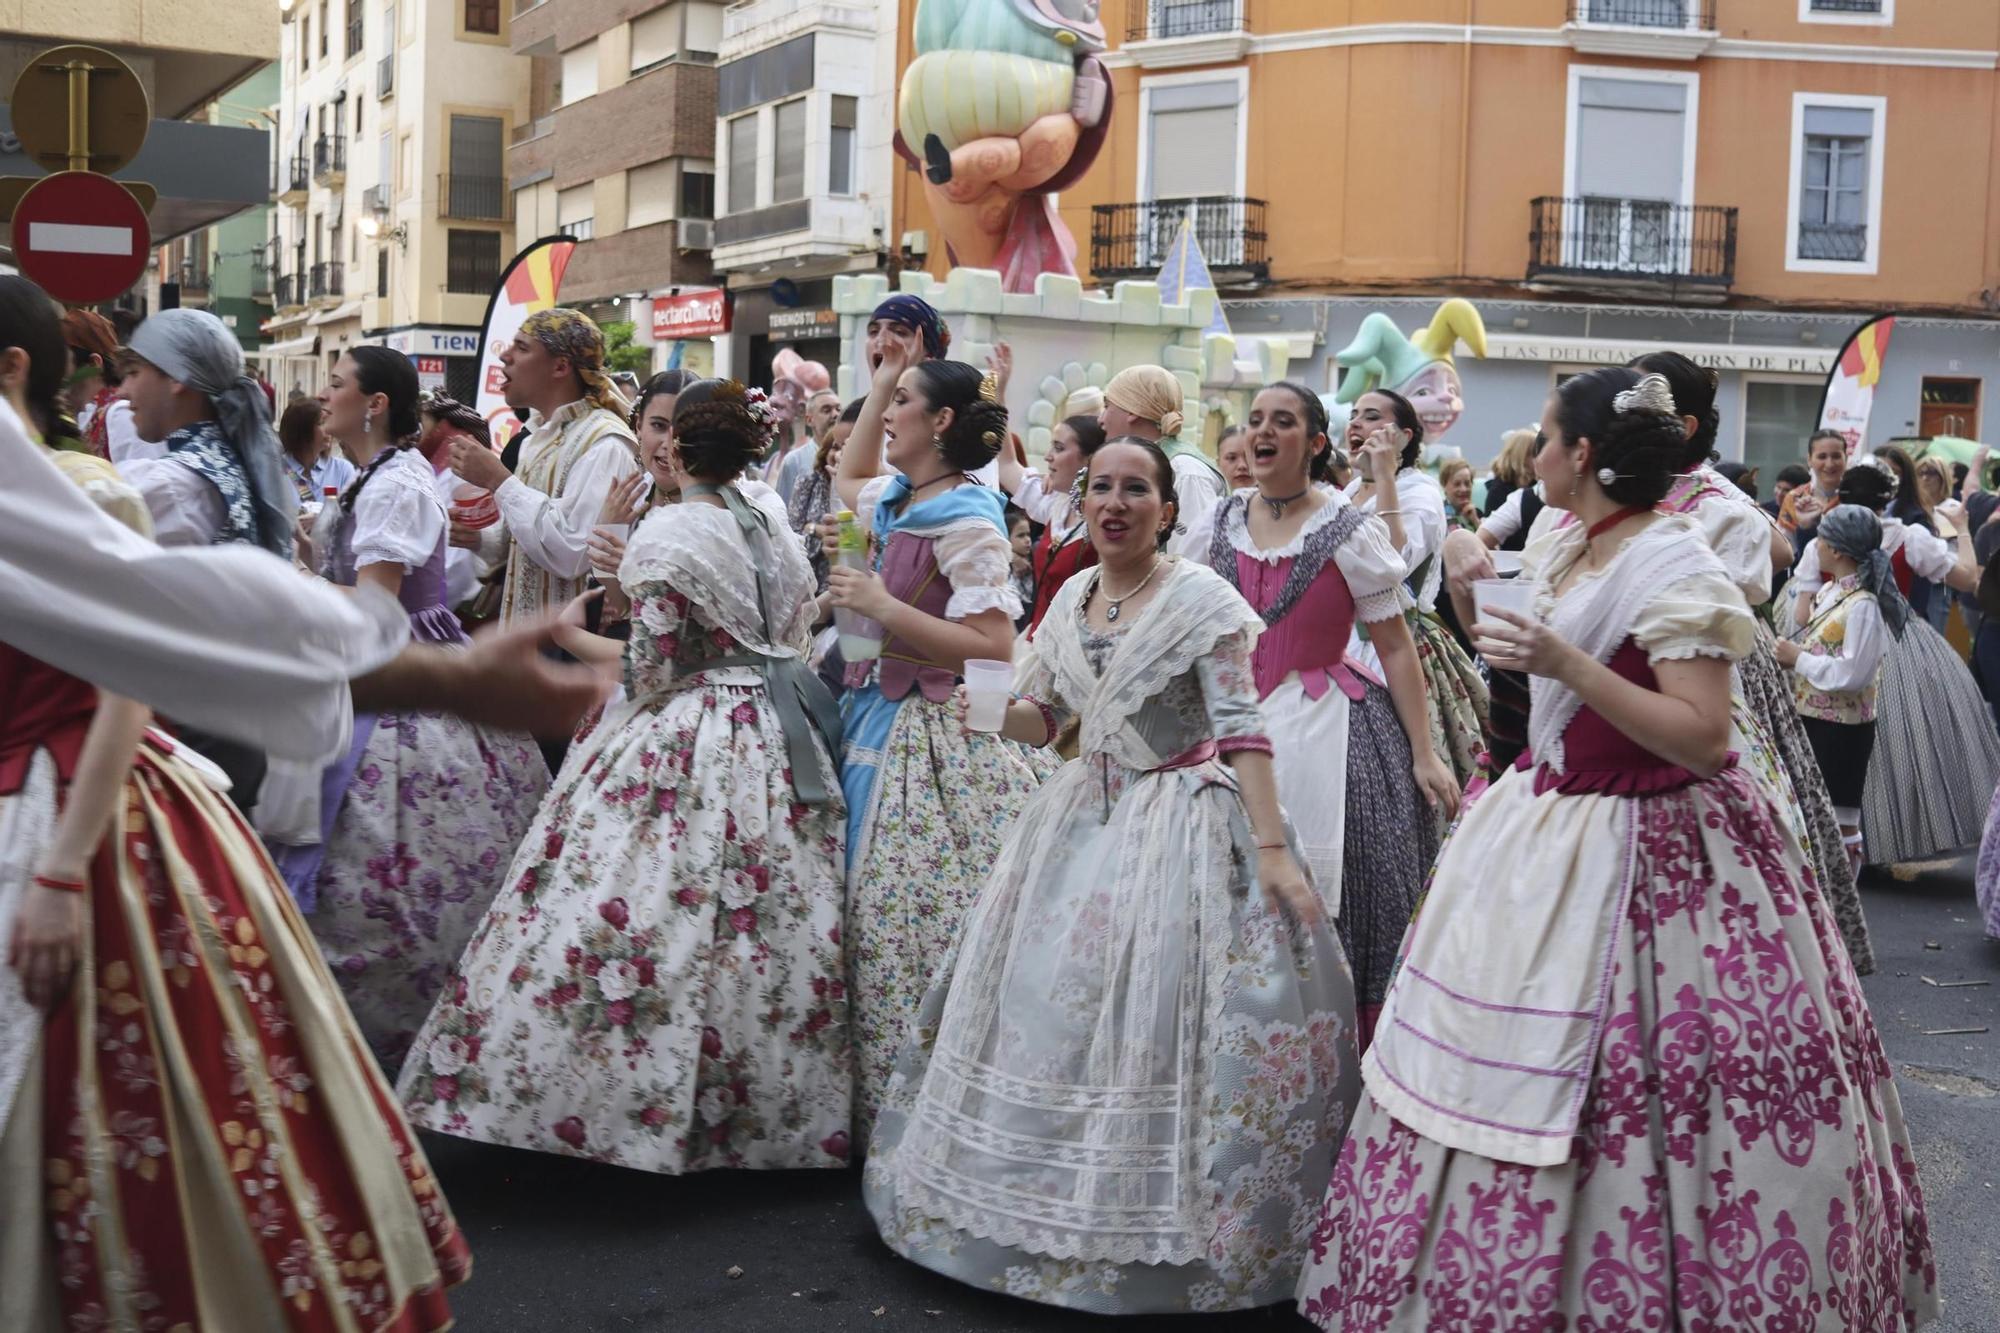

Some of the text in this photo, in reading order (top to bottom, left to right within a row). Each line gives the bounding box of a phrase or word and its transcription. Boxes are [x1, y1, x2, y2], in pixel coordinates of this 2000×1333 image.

[1502, 346, 1538, 358] LAS
[420, 361, 443, 371] T21
[1682, 352, 1737, 367] ORN
[1750, 357, 1774, 369] DE
